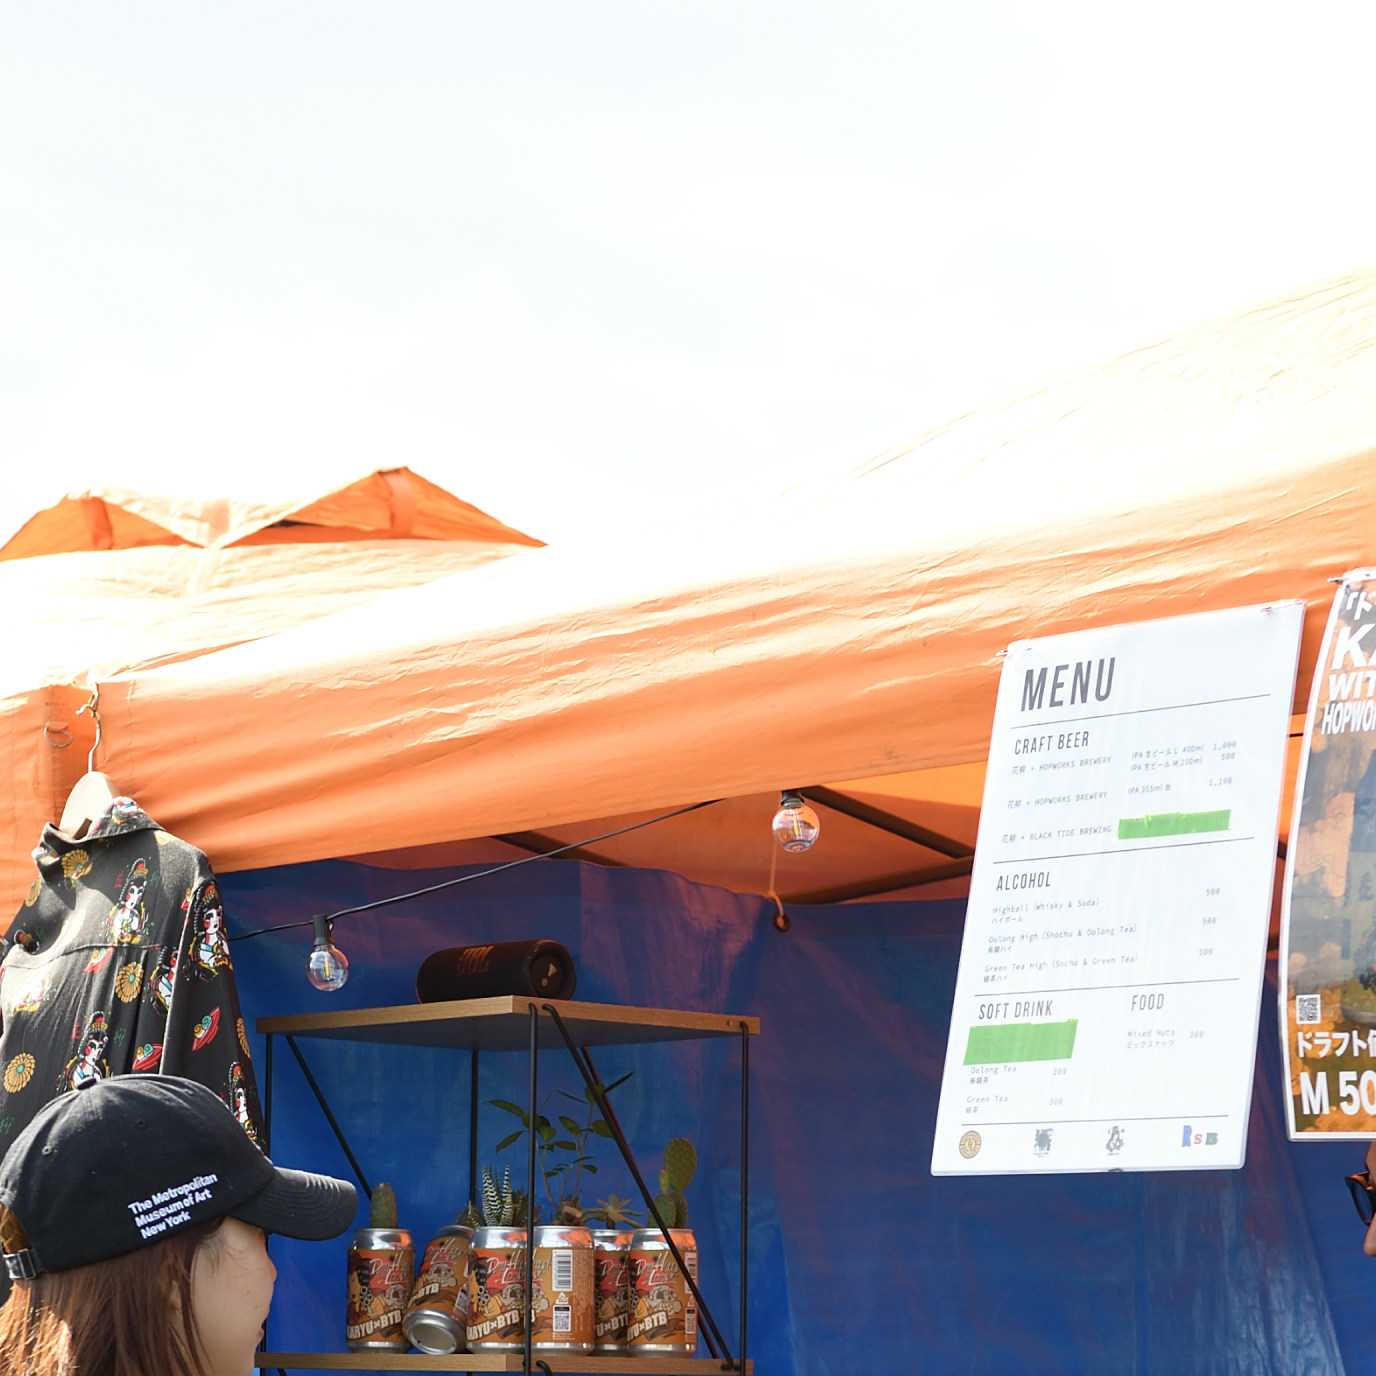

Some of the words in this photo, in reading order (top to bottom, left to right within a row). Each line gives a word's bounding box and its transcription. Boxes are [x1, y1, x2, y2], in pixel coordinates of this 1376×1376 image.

[1020, 657, 1116, 711] MENU
[1014, 736, 1053, 755] CRAFT
[1058, 731, 1090, 749] BEER
[1039, 760, 1075, 771] HOPWORKS
[1080, 756, 1112, 766] BREWERY
[1035, 795, 1071, 806] HOPWORKS
[1076, 791, 1107, 802] BREWERY
[1030, 831, 1052, 840] BLACK
[1057, 828, 1075, 837] TIDE
[1080, 826, 1112, 836] BREWING
[996, 871, 1051, 891] ALCOHOL
[978, 1003, 1010, 1020] SOFT
[1014, 1000, 1054, 1018] DRINK
[1131, 994, 1165, 1011] FOOD
[1298, 1072, 1330, 1115] M
[128, 1197, 153, 1215] The
[152, 1173, 219, 1206] Metropolitan
[135, 1202, 184, 1228] Museum
[183, 1194, 195, 1211] of
[194, 1188, 212, 1206] Art
[140, 1221, 167, 1240] New
[165, 1210, 191, 1231] York
